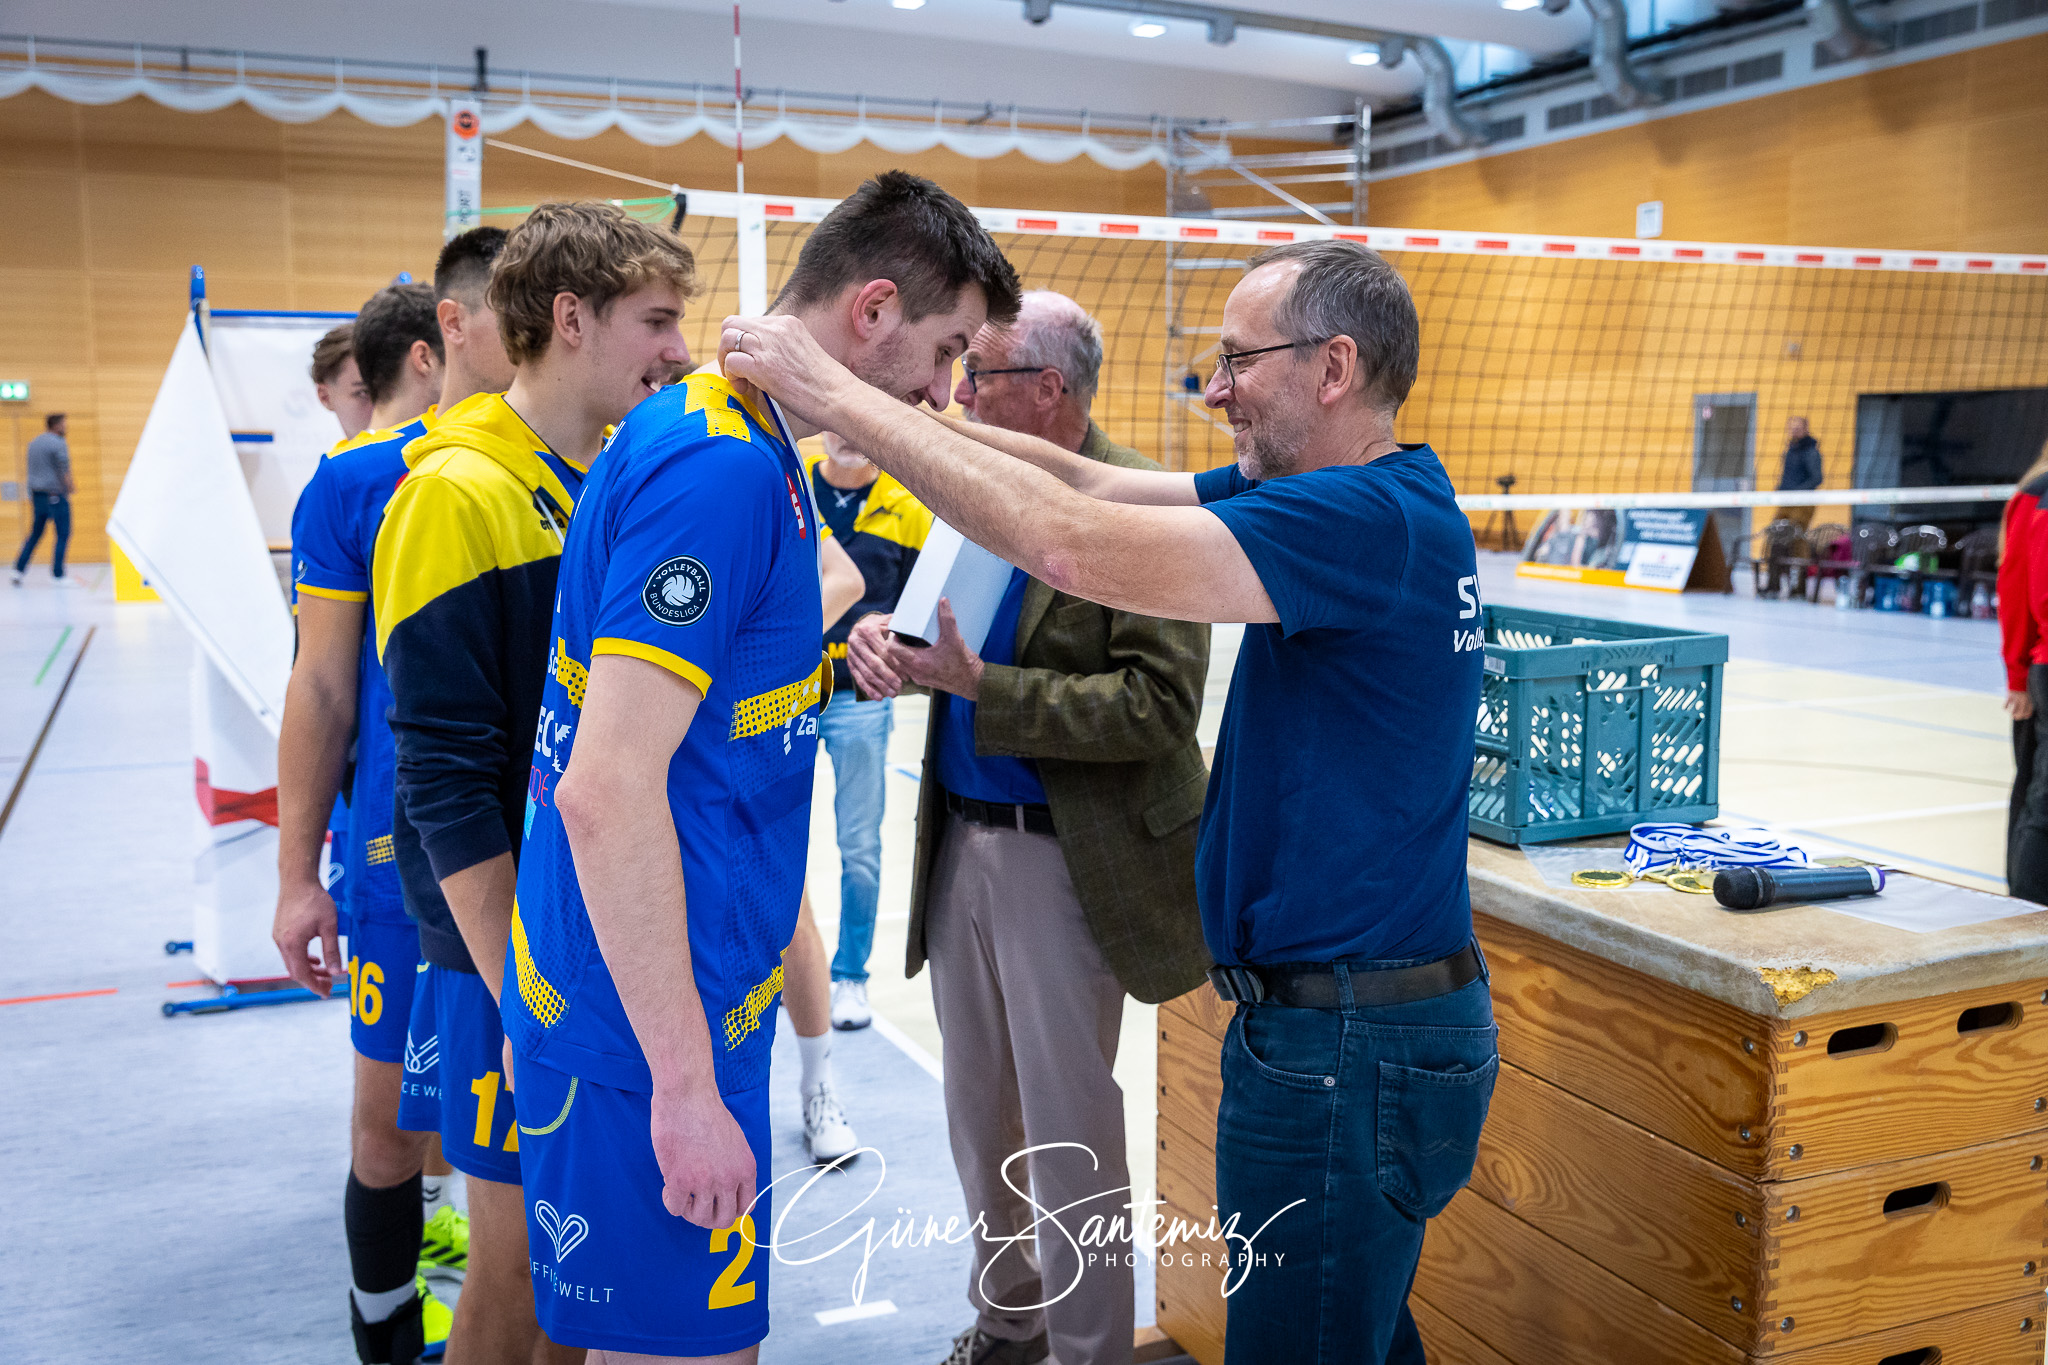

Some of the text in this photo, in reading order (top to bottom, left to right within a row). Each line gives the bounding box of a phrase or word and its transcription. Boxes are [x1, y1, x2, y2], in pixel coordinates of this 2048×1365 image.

[656, 563, 707, 592] VOLLEYBALL
[650, 592, 700, 618] BUNDESLIGA
[796, 713, 820, 740] Za
[348, 955, 385, 1025] 16
[708, 1214, 756, 1310] 2
